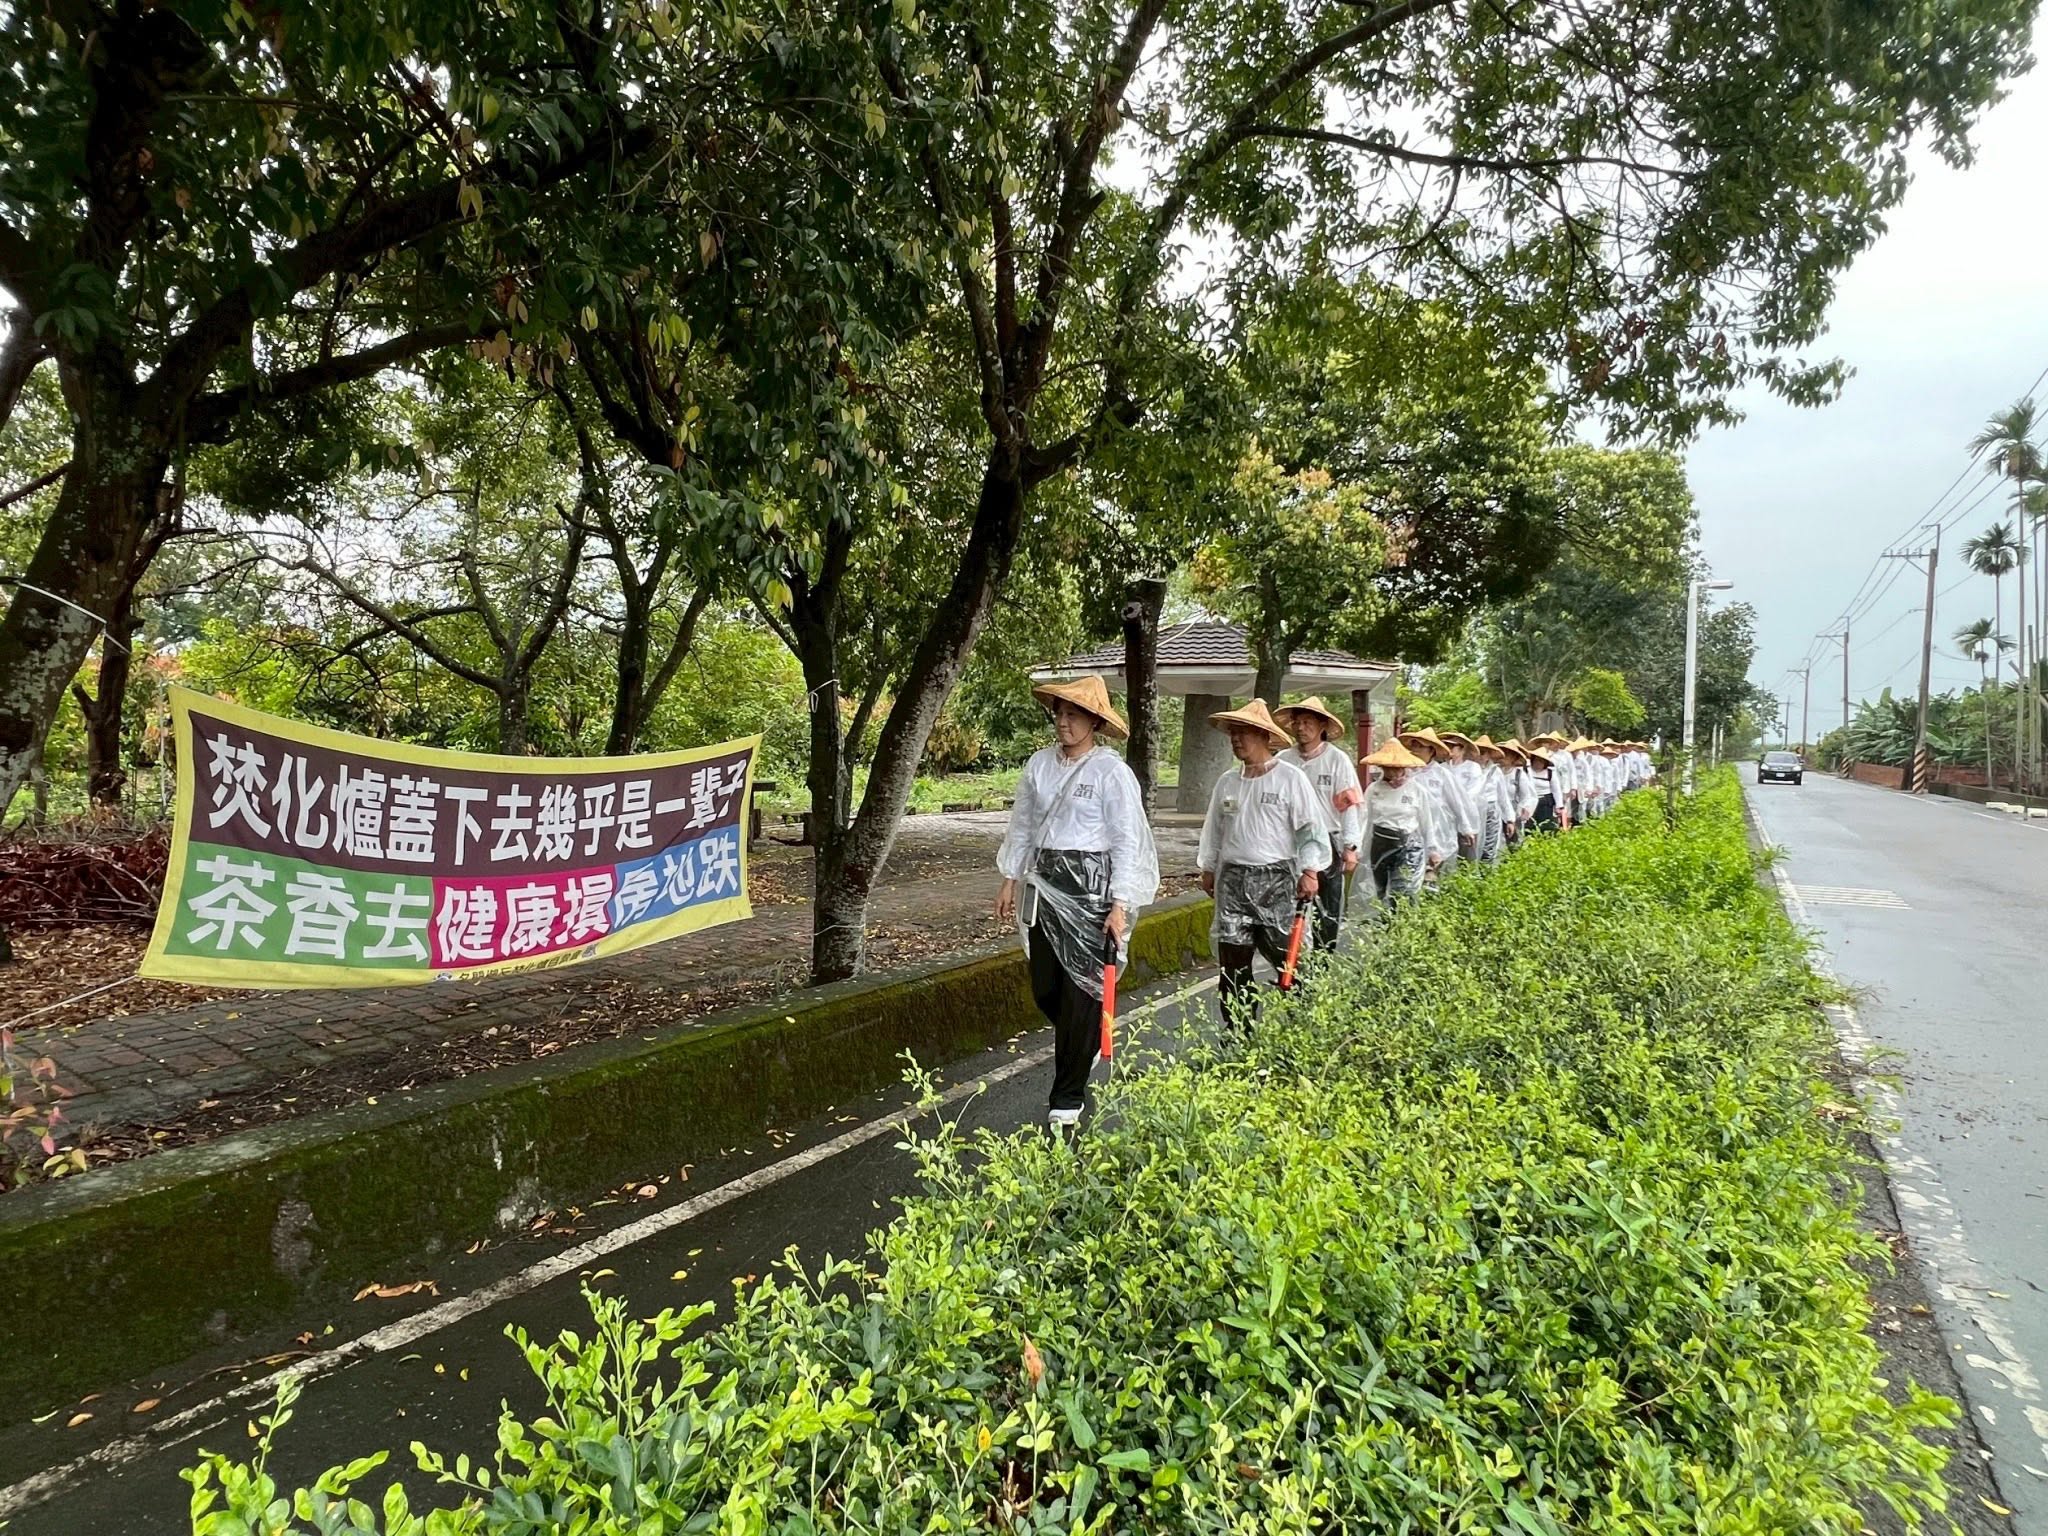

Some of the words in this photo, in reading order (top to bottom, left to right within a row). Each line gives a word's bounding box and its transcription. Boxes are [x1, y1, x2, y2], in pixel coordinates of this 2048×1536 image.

[206, 734, 747, 866] 焚化爐蓋下去幾乎是一輩子
